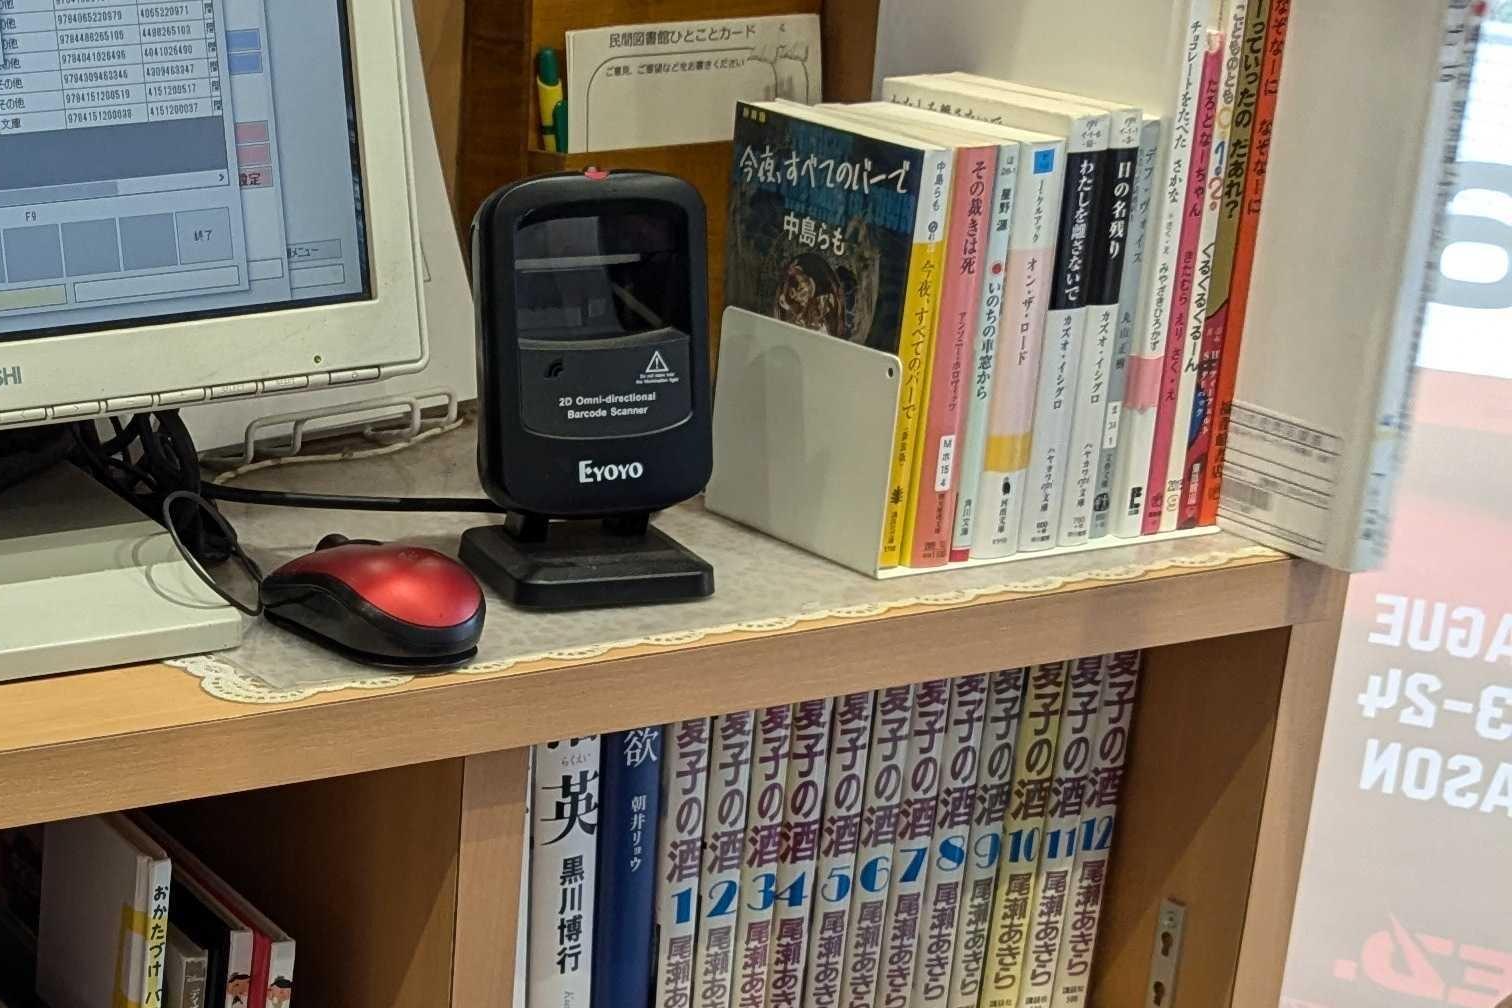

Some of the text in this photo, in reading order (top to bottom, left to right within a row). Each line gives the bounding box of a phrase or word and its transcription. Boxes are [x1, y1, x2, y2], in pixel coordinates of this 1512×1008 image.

[1174, 21, 1202, 149] チョコレートをたべた
[1, 118, 21, 129] 文庫
[739, 144, 908, 196] 今夜、すべてのバーで
[1168, 160, 1182, 203] さかな
[782, 212, 846, 255] 中島らも
[960, 161, 987, 275] その裁きは死
[1053, 159, 1095, 410] わたしを離さないで カズオ・イシグロ
[1090, 161, 1132, 405] 日の名残り カズオ・イシグロ
[1017, 257, 1037, 365] オン・ザ・ロード
[1184, 243, 1215, 373] くるくるくるーん
[976, 282, 1000, 401] いのちの車窓から
[559, 392, 656, 406] 2D Omni-directional
[568, 406, 648, 419] Barcode Scanner
[629, 795, 647, 872] 朝井リョウ
[974, 833, 1000, 870] 9
[1008, 828, 1038, 863] 10
[1045, 827, 1077, 859] 11
[1081, 816, 1113, 850] 12
[541, 769, 599, 975] 英 黒川博行
[899, 847, 928, 883] 7
[938, 835, 966, 871] 8
[747, 875, 776, 912] 3
[775, 871, 807, 909] 4
[821, 864, 852, 902] 5
[860, 856, 889, 893] 6
[672, 888, 693, 926] 1
[708, 881, 737, 919] 2
[147, 884, 169, 978] おかたづけ
[994, 872, 1030, 989] 尾瀬あきら
